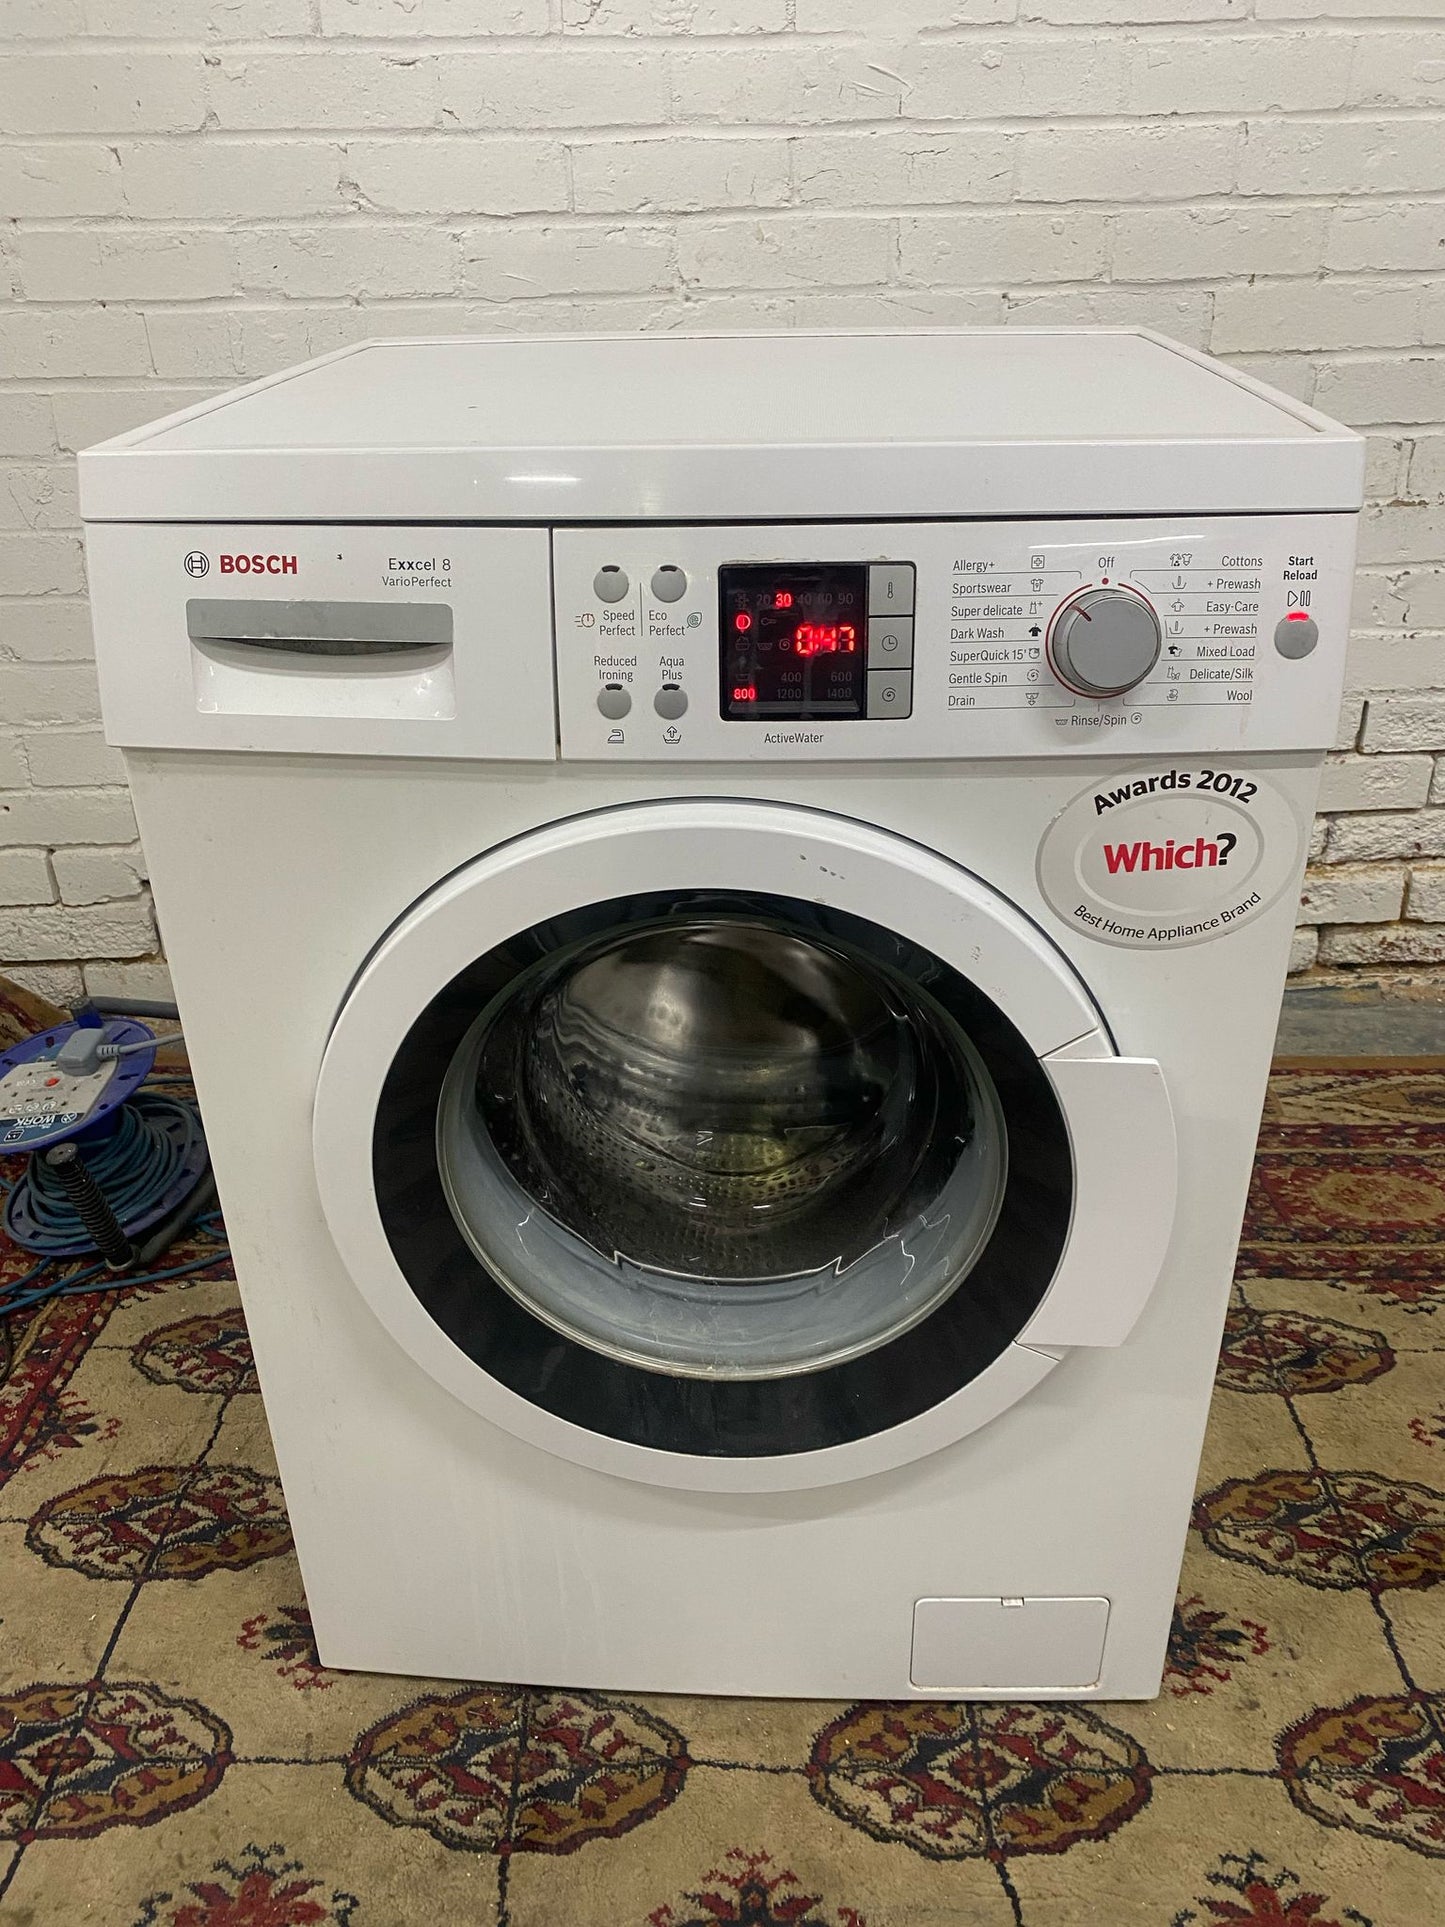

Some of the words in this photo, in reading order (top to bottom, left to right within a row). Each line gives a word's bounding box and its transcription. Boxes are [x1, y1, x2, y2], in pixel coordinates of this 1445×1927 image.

[220, 555, 297, 574] BOSCH
[389, 558, 436, 571] Exxcel
[443, 559, 451, 571] 8
[953, 559, 995, 573] Allergy+
[1098, 557, 1115, 569] Off
[1221, 555, 1263, 567] Cottons
[1288, 556, 1313, 566] Start
[1283, 569, 1317, 580] Reload
[382, 576, 452, 588] VarioPerfect
[1216, 578, 1261, 590] Prewash
[952, 582, 1011, 595] Sportswear
[776, 593, 792, 606] 30
[797, 594, 811, 605] 40
[838, 593, 853, 604] 90
[951, 605, 980, 617] Super
[983, 604, 1022, 616] delicate
[1206, 601, 1259, 614] Easy-Care
[603, 610, 634, 621] Speed
[649, 611, 667, 620] Eco
[600, 626, 635, 636] Perfect
[650, 626, 685, 636] Perfect
[950, 628, 974, 639] Dark
[977, 627, 1004, 638] Wash
[1213, 623, 1257, 635] Prewash
[796, 626, 855, 654] 0:47
[950, 650, 1009, 662] SuperQuick
[1196, 646, 1227, 657] Mixed
[1230, 645, 1255, 657] Load
[594, 656, 636, 666] Reduced
[660, 656, 684, 668] Aqua
[599, 670, 633, 682] Ironing
[662, 670, 682, 679] Plus
[781, 672, 801, 682] 400
[831, 672, 852, 681] 600
[949, 672, 984, 684] Gentle
[986, 671, 1008, 685] Spin
[1189, 667, 1254, 680] Delicate/Silk
[734, 688, 756, 699] 800
[777, 689, 801, 698] 1200
[827, 688, 851, 698] 1400
[1227, 690, 1252, 701] Wool
[948, 694, 975, 706] Drain
[1071, 713, 1126, 726] Rinse/Spin
[765, 734, 823, 743] ActiveWater
[1093, 770, 1191, 816] Awards
[1196, 770, 1257, 804] 2012
[1104, 833, 1237, 874] Which?
[1074, 904, 1102, 927] Best
[1102, 919, 1145, 939] Home
[1147, 918, 1219, 941] Appliance
[1221, 892, 1261, 923] Brand
